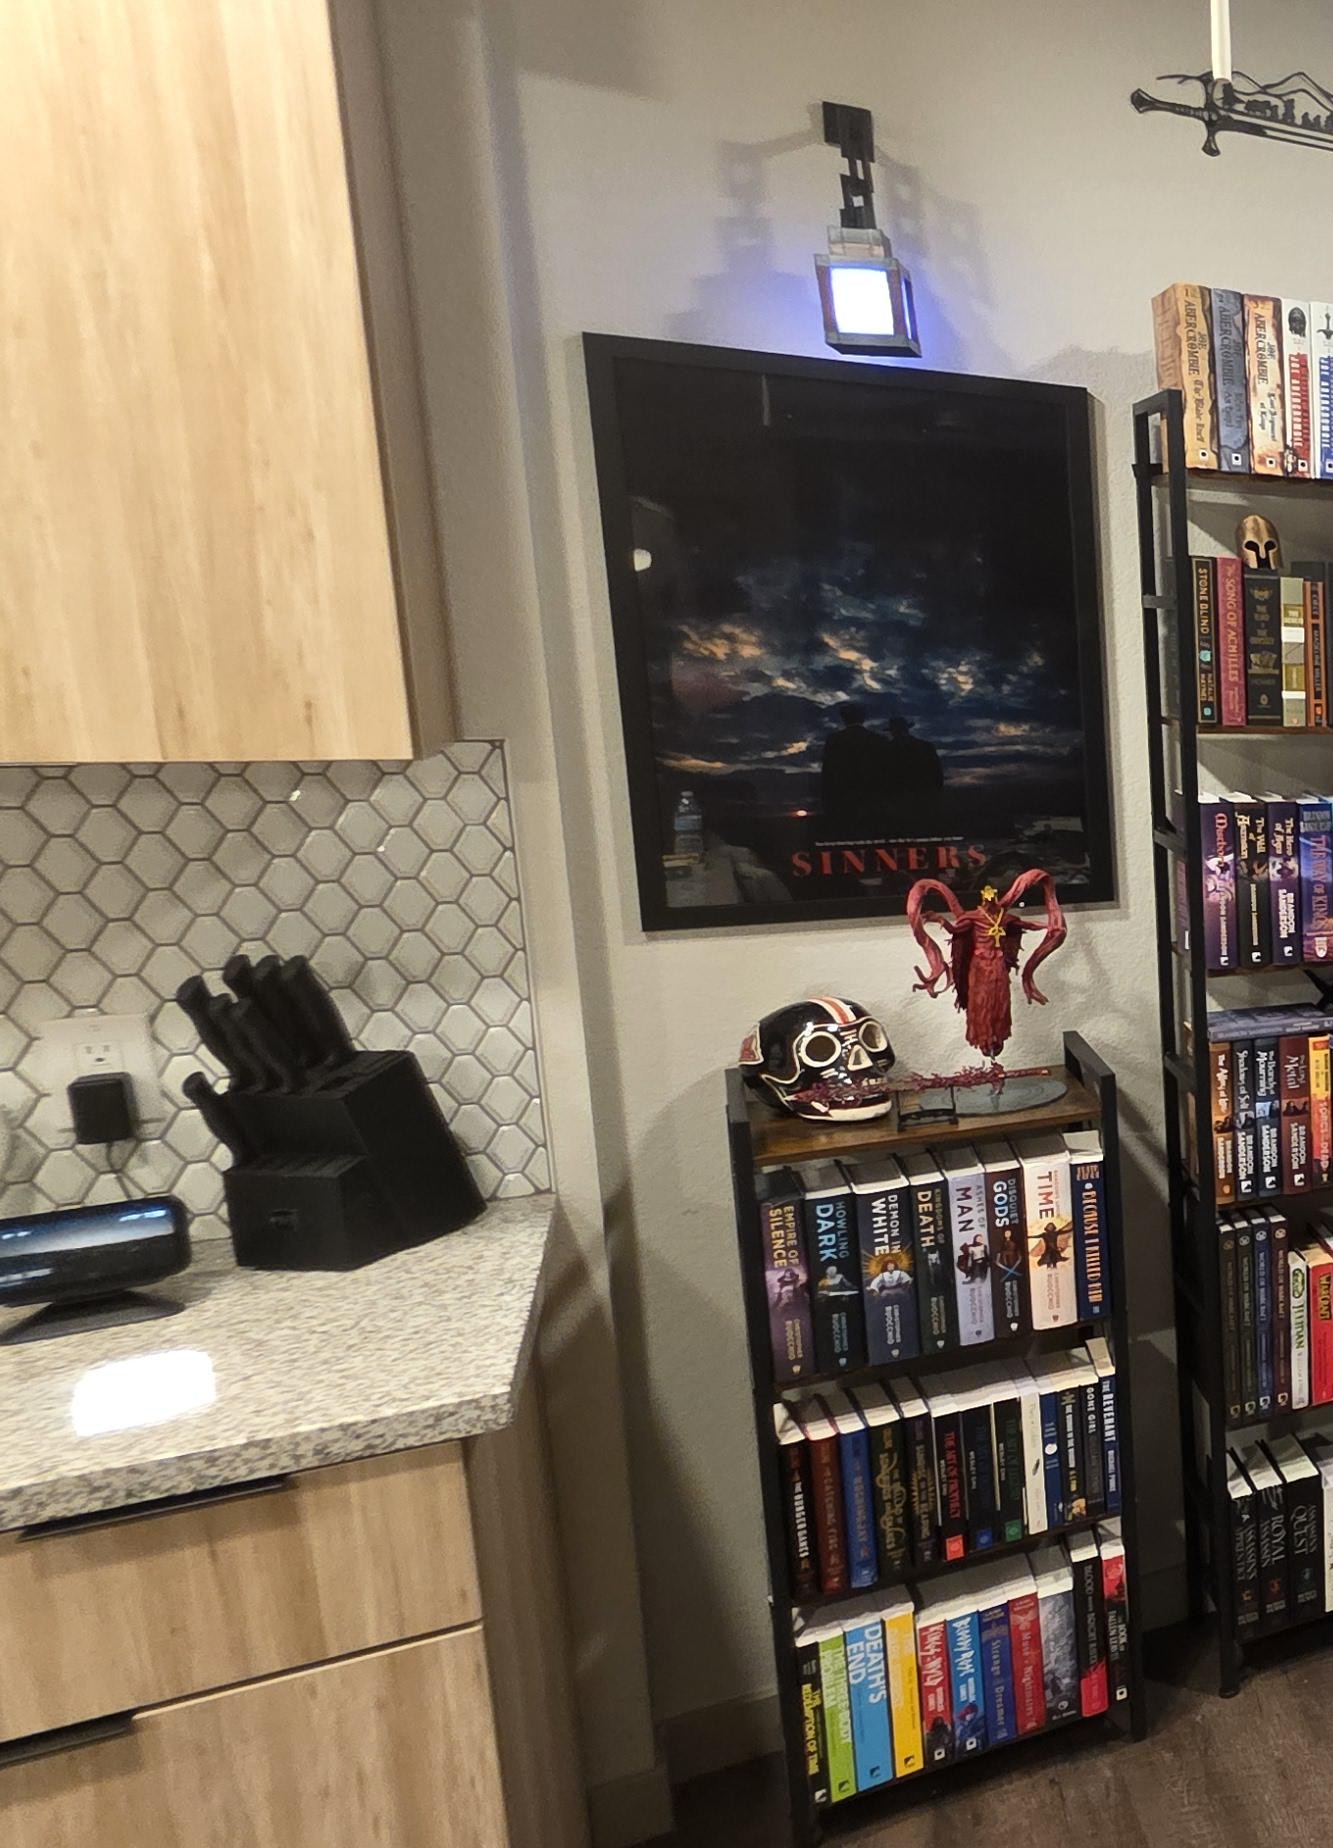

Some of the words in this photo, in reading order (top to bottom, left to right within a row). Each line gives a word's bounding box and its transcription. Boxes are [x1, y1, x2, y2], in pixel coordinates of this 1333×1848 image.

[1184, 300, 1199, 376] ABERCROMBIE
[1219, 306, 1233, 386] ABERCROMBIE
[1254, 313, 1269, 385] ABERCROMBIE
[1199, 568, 1209, 601] STONE
[1226, 578, 1236, 609] SONG
[1200, 603, 1210, 634] BLIND
[1227, 612, 1237, 626] OF
[1227, 629, 1239, 681] ACHILLES
[792, 844, 988, 876] SINNERS
[1286, 837, 1294, 856] Hero
[1312, 861, 1328, 882] WAY
[1278, 889, 1286, 938] SANDERSON
[1312, 896, 1328, 930] KINGS
[1284, 1056, 1299, 1089] Metal
[1237, 1132, 1246, 1180] SANDERSON
[1262, 1125, 1270, 1172] SANDERSON
[1290, 1123, 1299, 1169] SANDERSON
[887, 1195, 899, 1238] DEMON
[956, 1187, 975, 1233] MAN
[976, 1184, 985, 1213] ASHES
[993, 1181, 1009, 1227] GODS
[1008, 1178, 1019, 1224] DISQUIET
[1037, 1171, 1054, 1219] TIME
[1082, 1190, 1099, 1236] BECAUSE
[769, 1208, 786, 1267] SILENCE
[783, 1206, 796, 1246] EMPIRE
[816, 1204, 837, 1262] DARK
[835, 1201, 848, 1259] HOWLING
[871, 1198, 888, 1257] WHITE
[917, 1191, 935, 1247] DEATH
[977, 1217, 986, 1230] OF
[787, 1250, 798, 1265] OF
[1004, 1281, 1013, 1318] RUOCCHIO
[1318, 1274, 1331, 1321] WARCRAFT
[831, 1313, 841, 1353] RUOCCHIO
[884, 1306, 894, 1344] RUOCCHIO
[1086, 1387, 1096, 1412] GONE
[1103, 1393, 1115, 1442] REVENANT
[1088, 1414, 1096, 1434] GIRL
[1271, 1515, 1286, 1565] ROYAL
[847, 1641, 866, 1685] END
[864, 1625, 887, 1704] DEATH'S
[991, 1640, 1003, 1675] Strange
[994, 1686, 1006, 1726] Dreamer
[807, 1742, 815, 1752] OF
